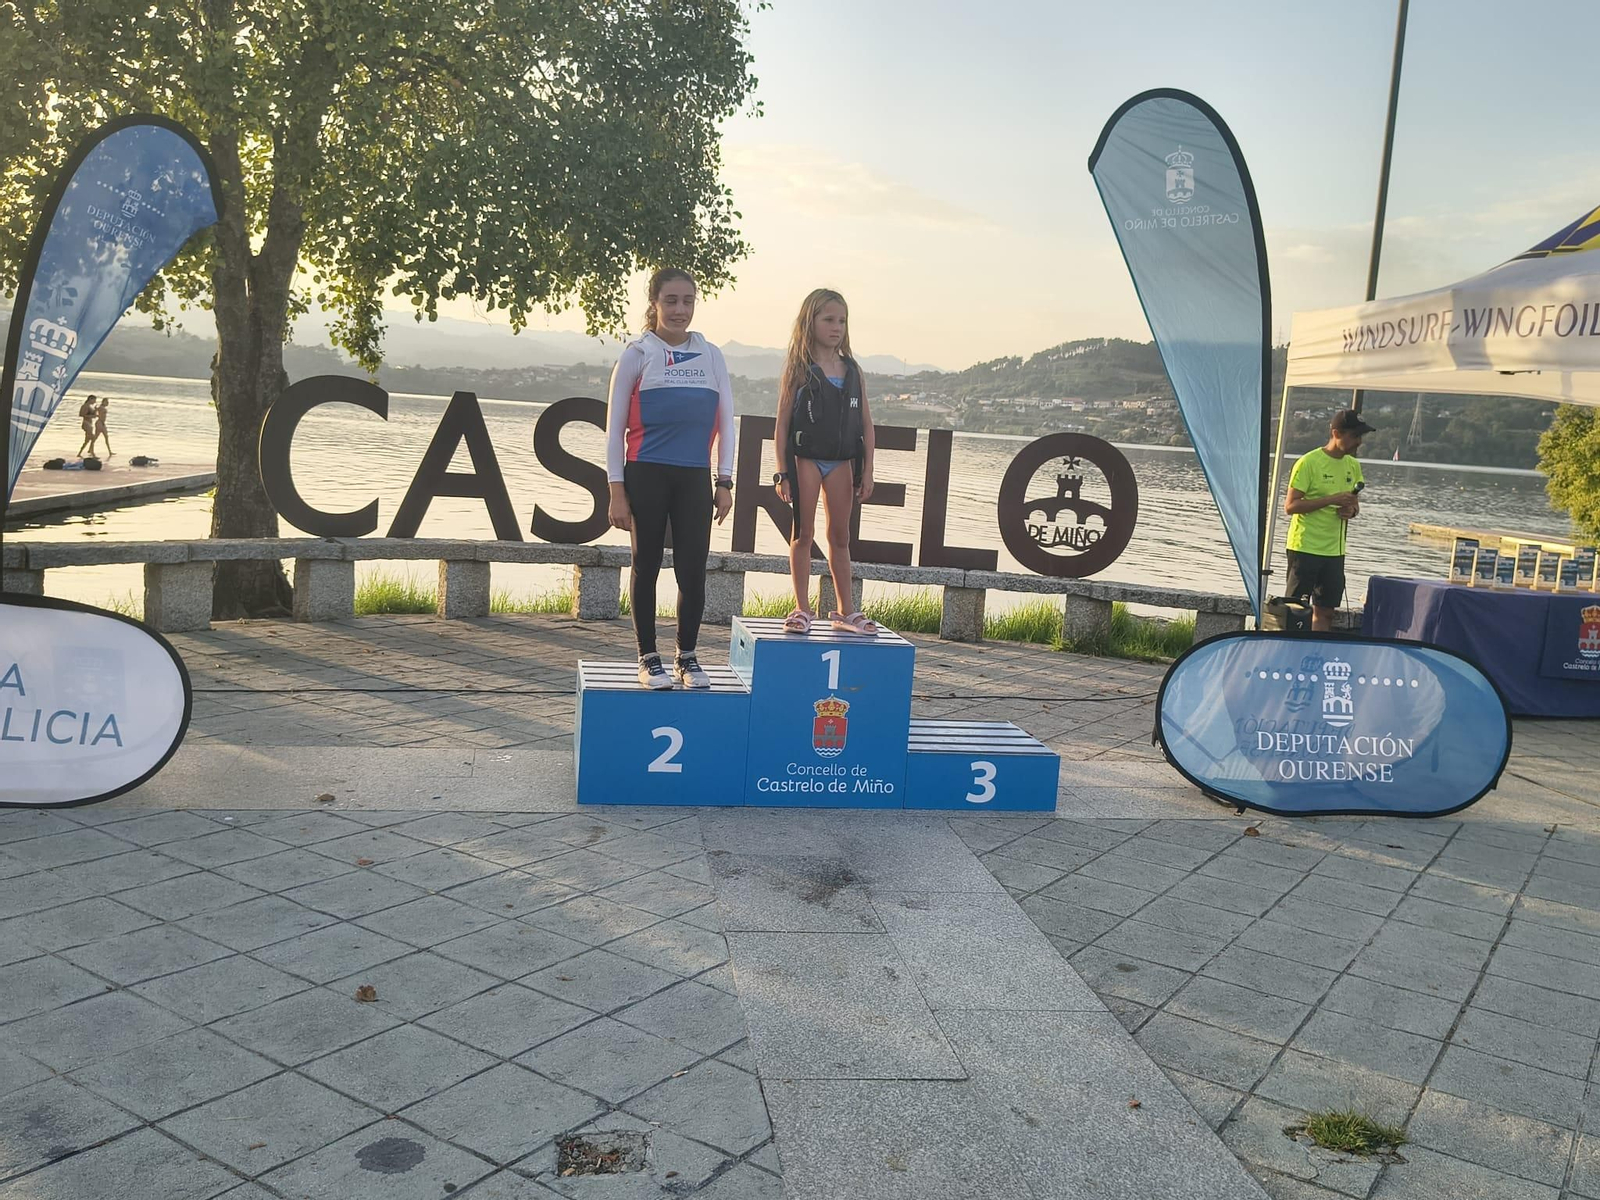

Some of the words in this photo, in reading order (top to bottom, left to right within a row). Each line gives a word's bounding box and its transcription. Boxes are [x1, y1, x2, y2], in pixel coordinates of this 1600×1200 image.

[664, 369, 706, 377] RODEIRA
[1028, 524, 1048, 542] DE
[1052, 526, 1101, 547] MIÑO
[820, 650, 841, 690] 1
[1, 706, 123, 747] LICIA
[647, 726, 684, 773] 2
[1256, 731, 1415, 759] DEPUTACIÓN
[786, 762, 847, 776] Concello
[851, 763, 868, 777] de
[965, 760, 997, 803] 3
[1278, 759, 1394, 783] OURENSE
[757, 777, 824, 792] Castrelo
[828, 778, 847, 793] de
[852, 779, 895, 794] Miño
